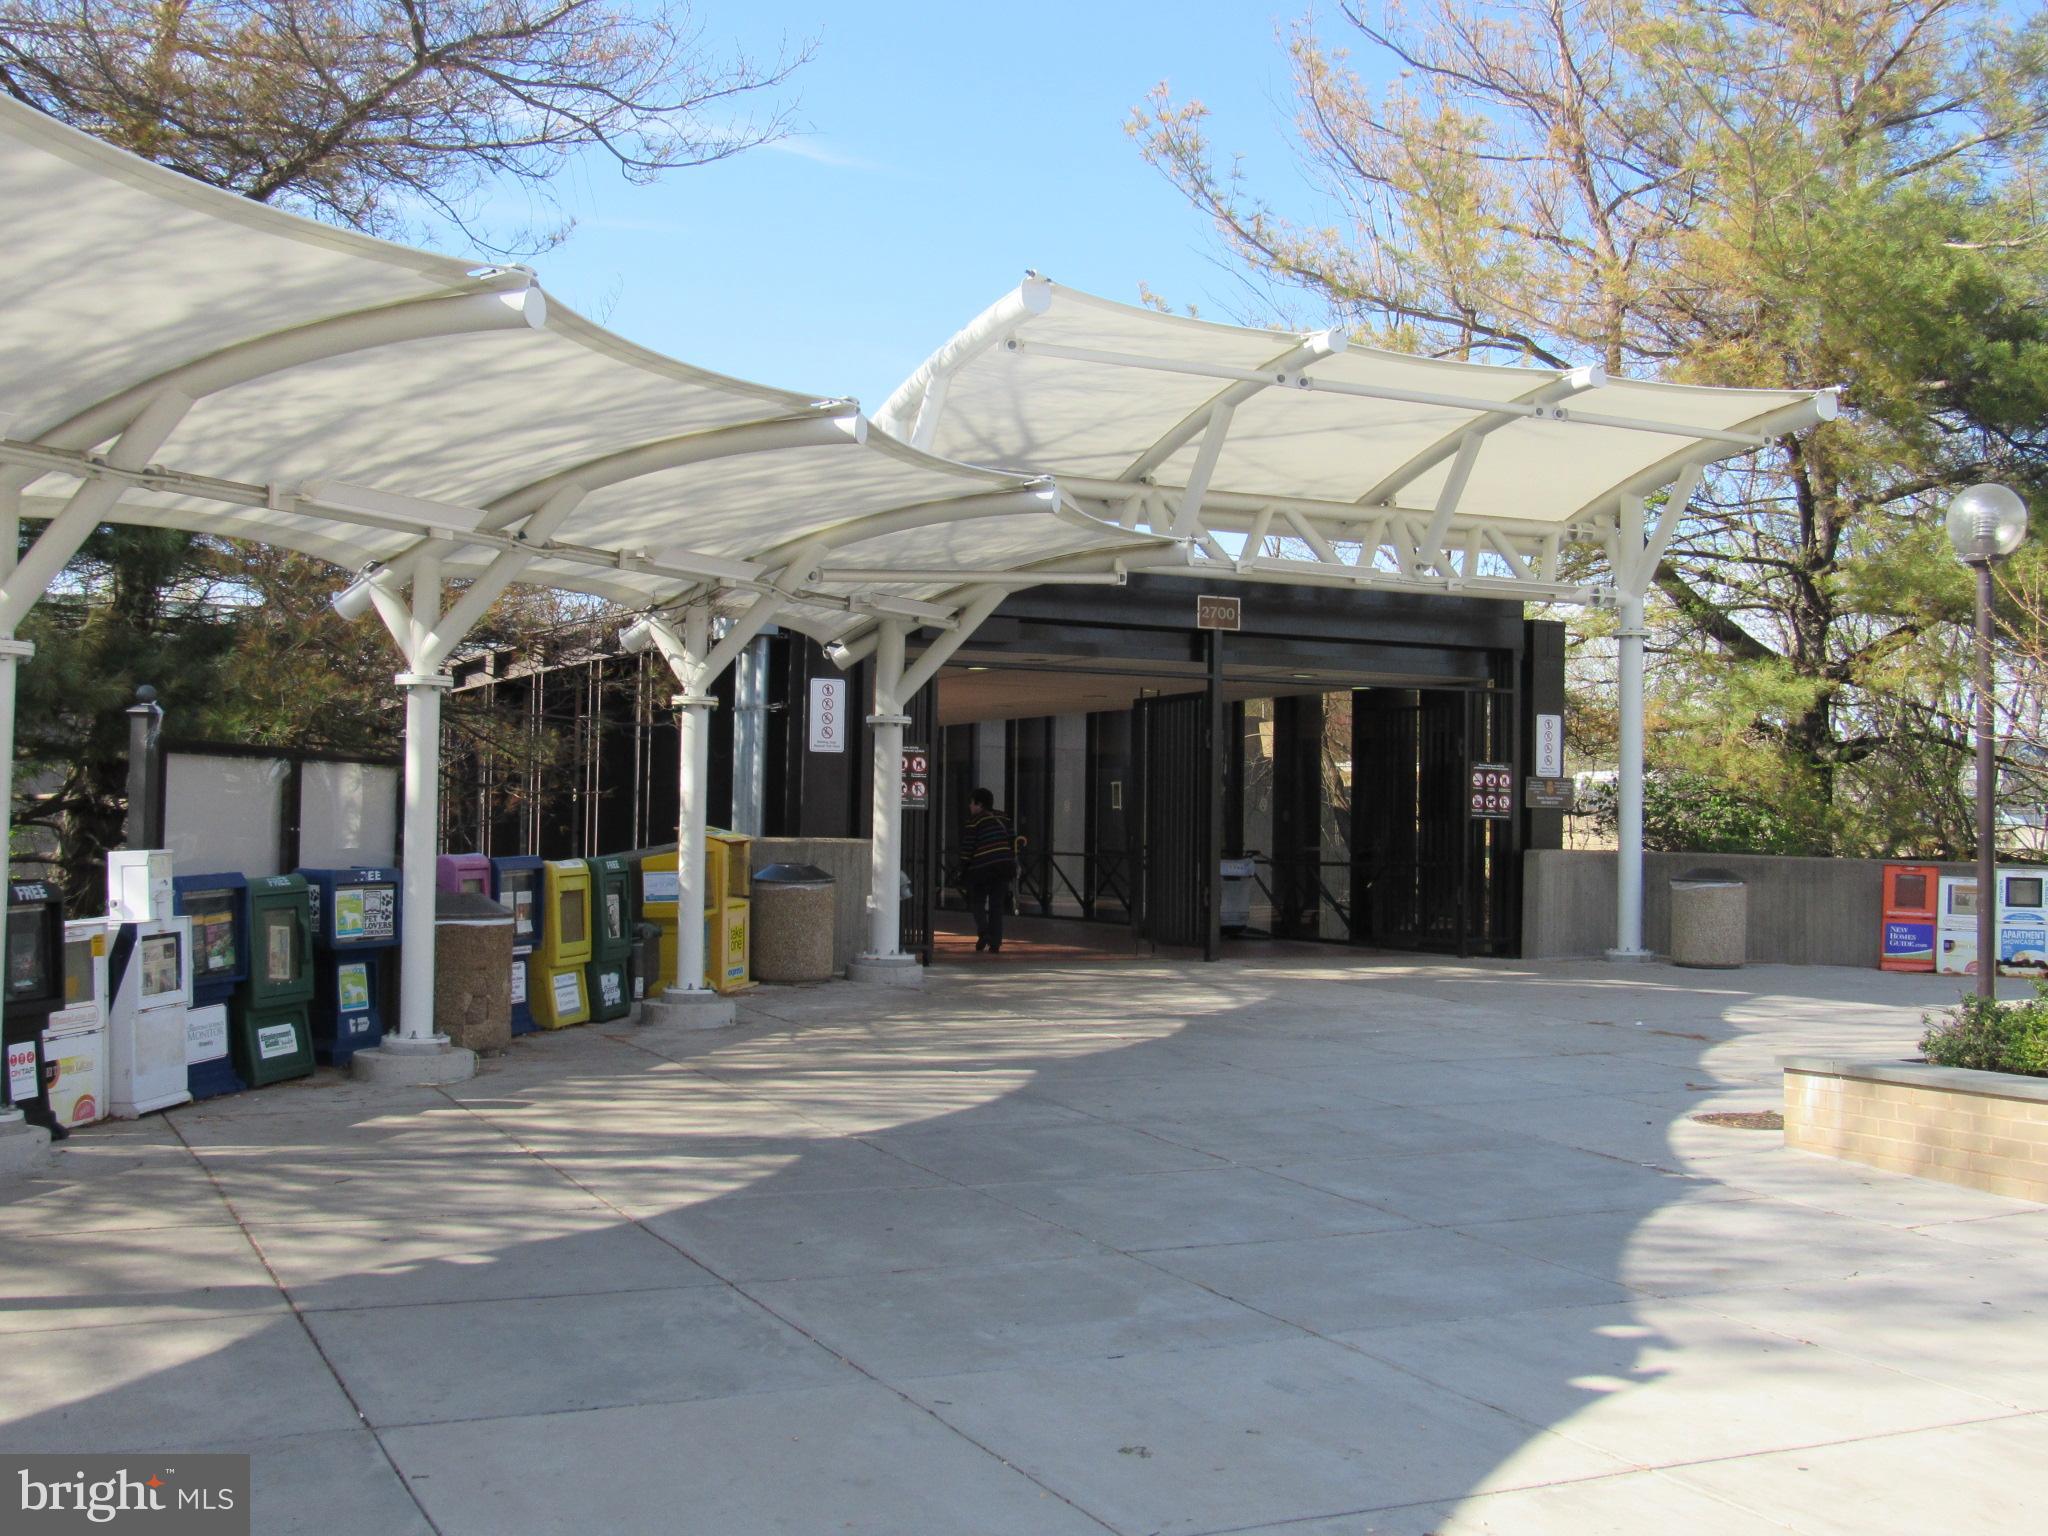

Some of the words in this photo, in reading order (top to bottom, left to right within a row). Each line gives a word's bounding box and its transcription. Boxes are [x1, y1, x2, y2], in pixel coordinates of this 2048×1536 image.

[1201, 606, 1236, 620] 2700
[606, 861, 620, 869] FREE
[266, 877, 291, 887] FREE
[14, 885, 48, 901] FREE
[364, 922, 393, 930] LOVERS
[1889, 933, 1917, 941] HOMES
[2002, 930, 2045, 940] APARTMENT
[731, 940, 743, 952] one
[187, 1029, 225, 1041] MONITOR
[20, 1066, 35, 1075] TAP
